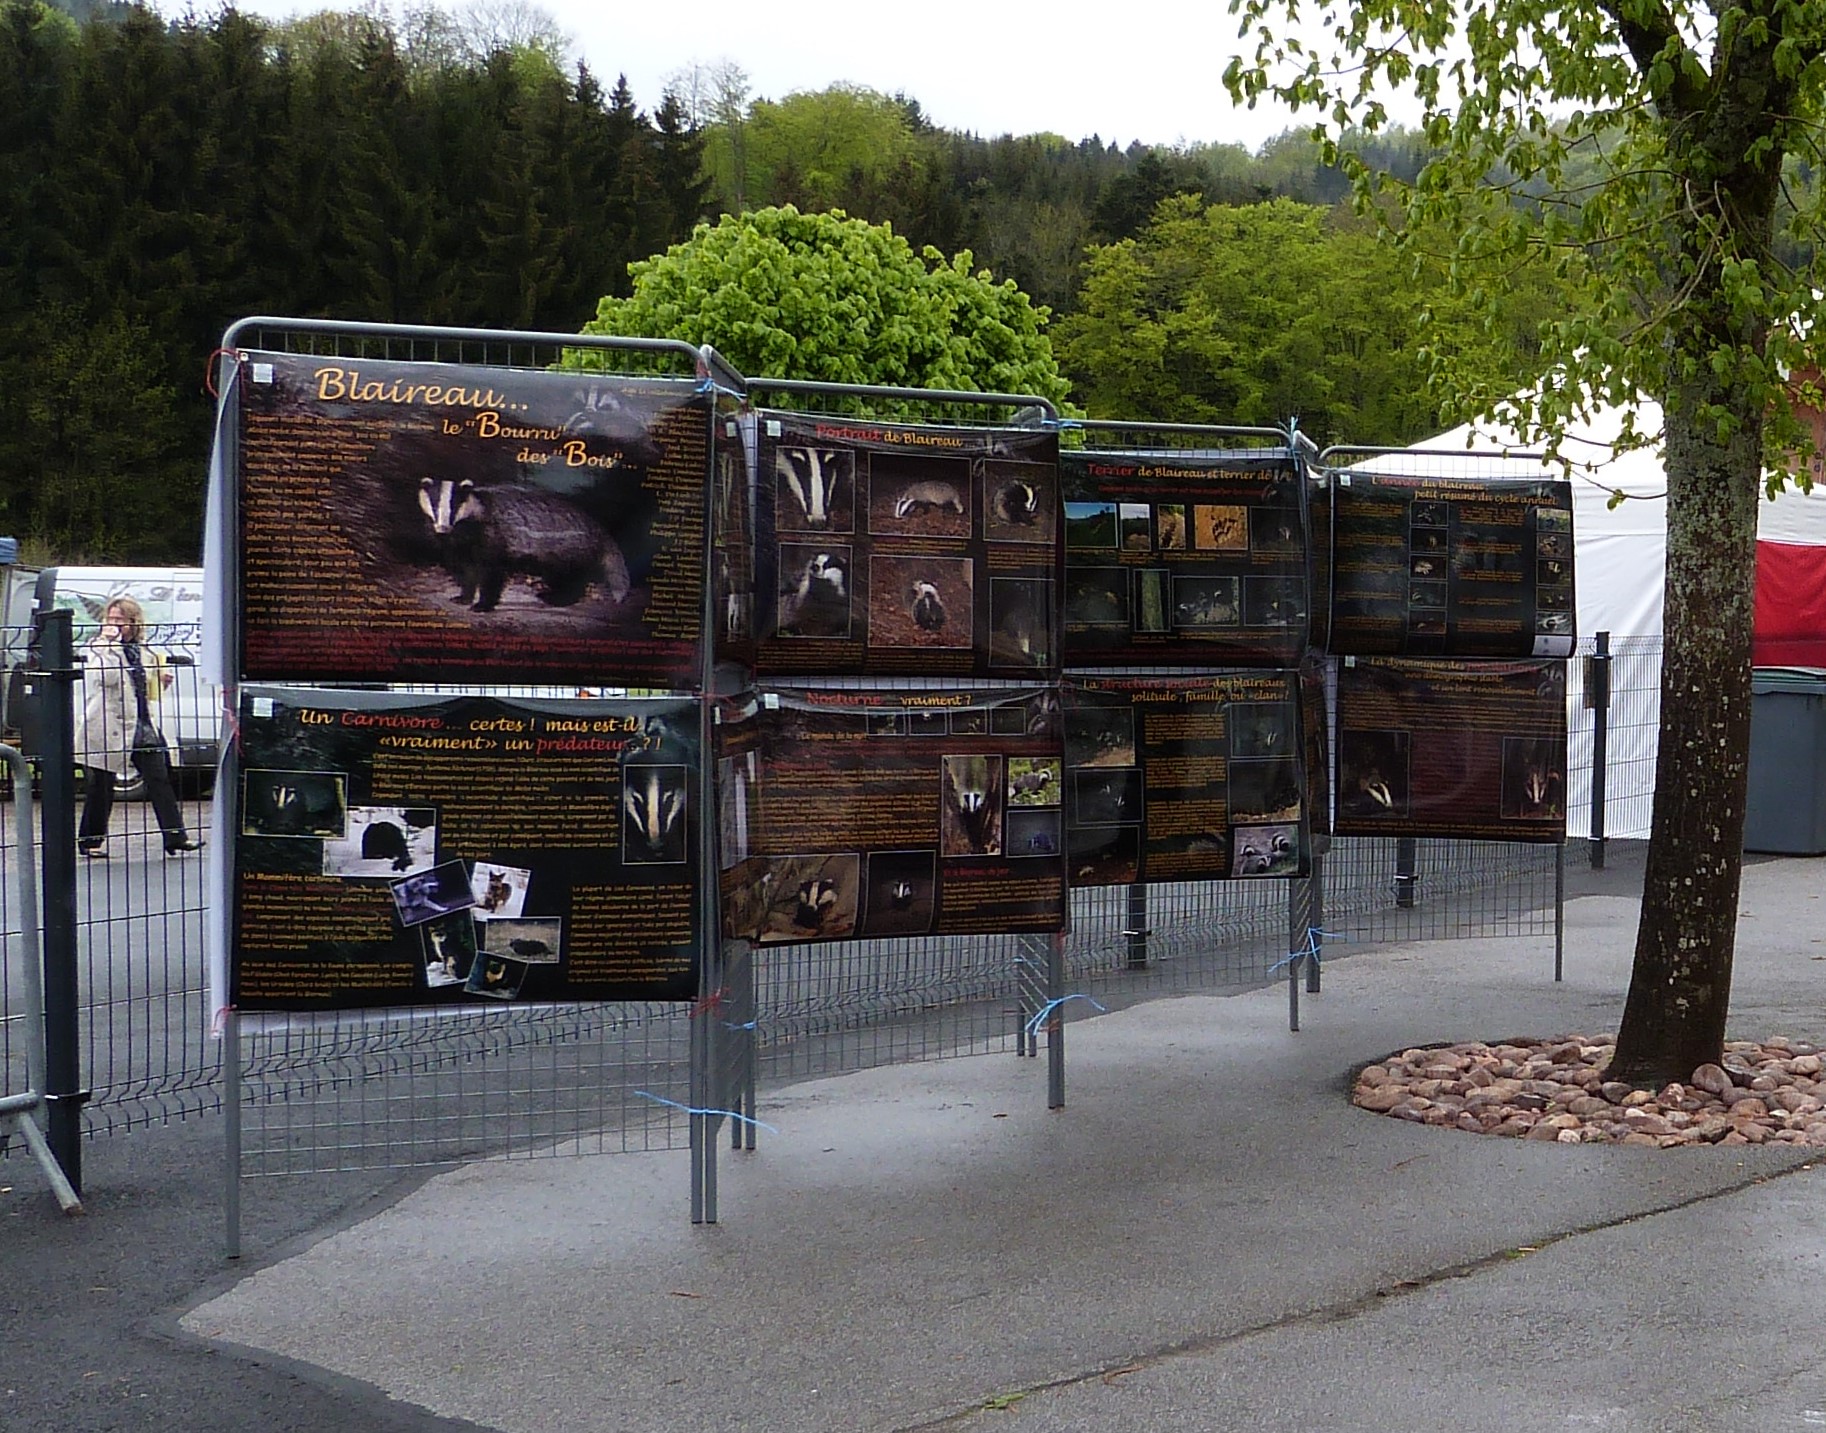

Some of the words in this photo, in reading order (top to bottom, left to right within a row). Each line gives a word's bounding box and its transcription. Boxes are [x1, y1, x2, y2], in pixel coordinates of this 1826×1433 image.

[314, 367, 528, 411] Blaireau...
[442, 418, 464, 436] le
[815, 424, 881, 442] Portrait
[883, 430, 901, 443] de
[516, 446, 551, 465] des
[1086, 462, 1135, 477] Terrier
[1137, 465, 1153, 477] de
[1154, 466, 1207, 479] Blaireau
[1220, 468, 1254, 481] terrier
[1421, 479, 1438, 489] du
[1414, 489, 1437, 500] petit
[1478, 491, 1495, 503] du
[1495, 492, 1519, 505] cycle
[1083, 679, 1099, 690] La
[806, 692, 882, 706] Nocturne
[900, 693, 964, 706] vraiment
[1131, 690, 1178, 704] solitude
[1185, 690, 1226, 703] famille
[300, 708, 335, 725] Un
[469, 716, 527, 733] certes
[545, 717, 590, 733] mais
[593, 716, 641, 733] est-il
[504, 738, 535, 751] un
